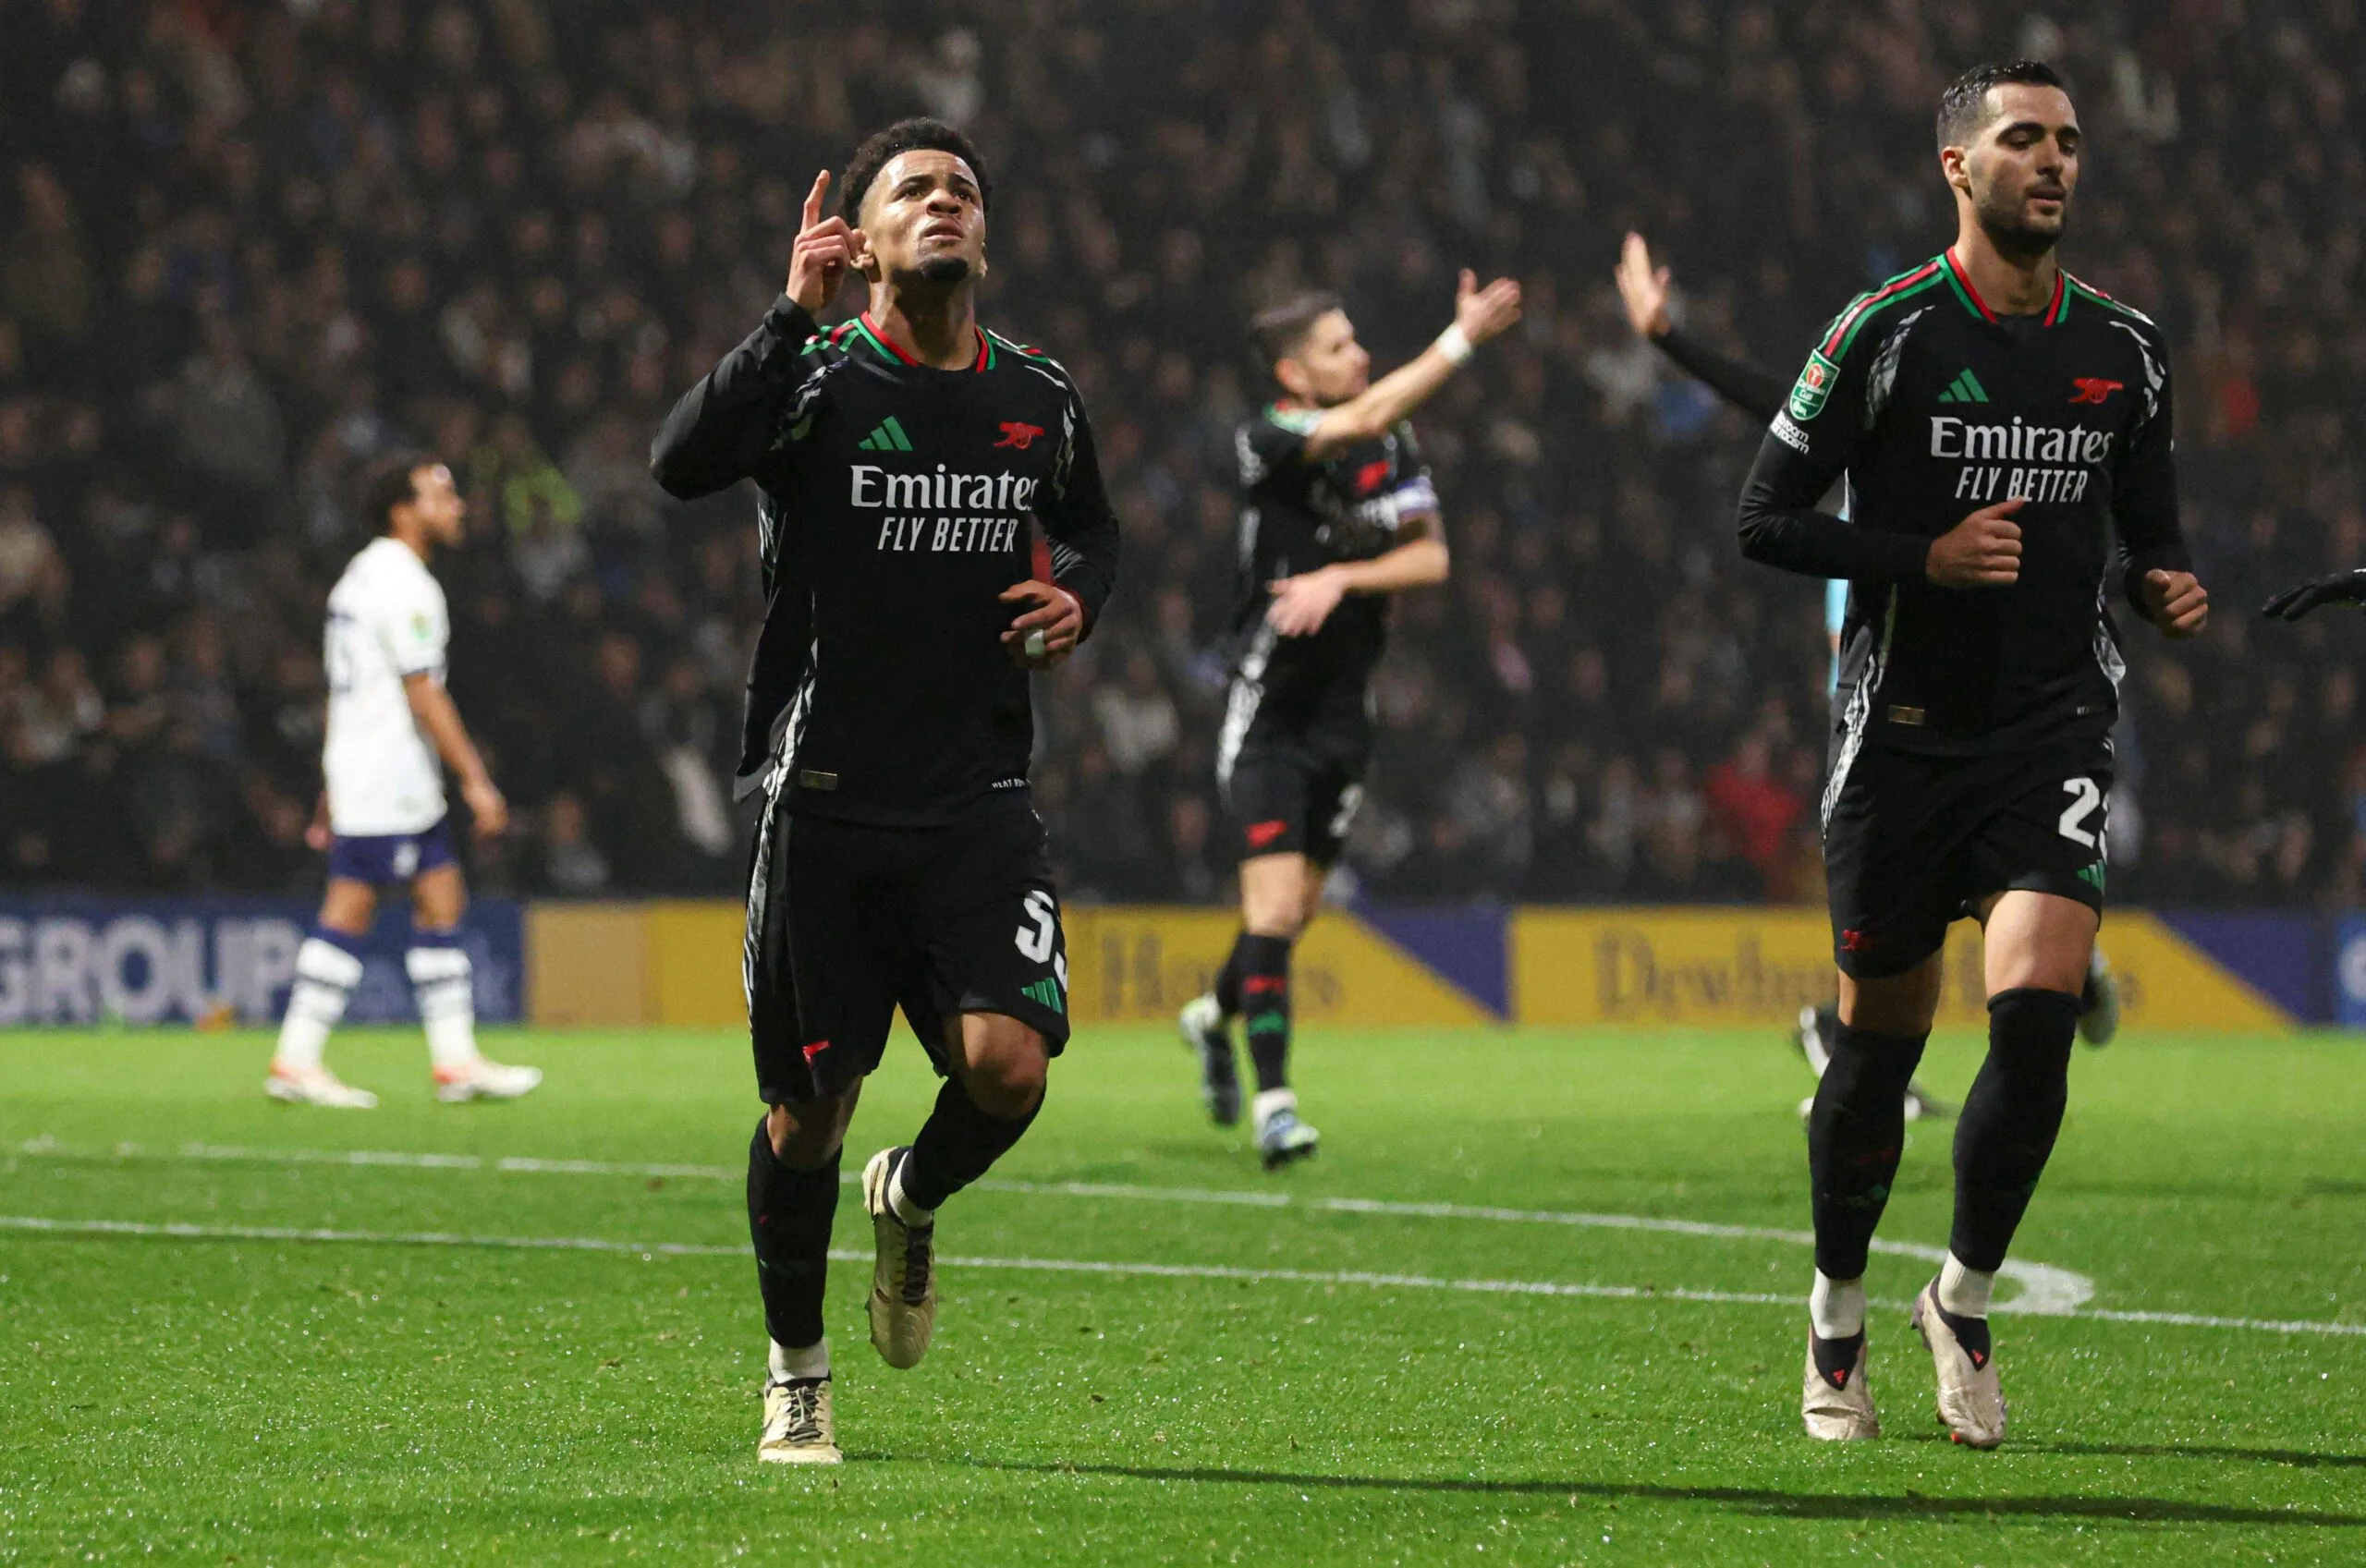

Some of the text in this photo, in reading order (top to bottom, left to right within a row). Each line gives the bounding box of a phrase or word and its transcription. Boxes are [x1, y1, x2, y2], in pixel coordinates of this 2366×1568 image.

[1930, 416, 2114, 463] Emirates
[1955, 467, 2088, 503] FLY BETTER
[877, 517, 1018, 553] FLY BETTER
[1014, 890, 1067, 992] 5
